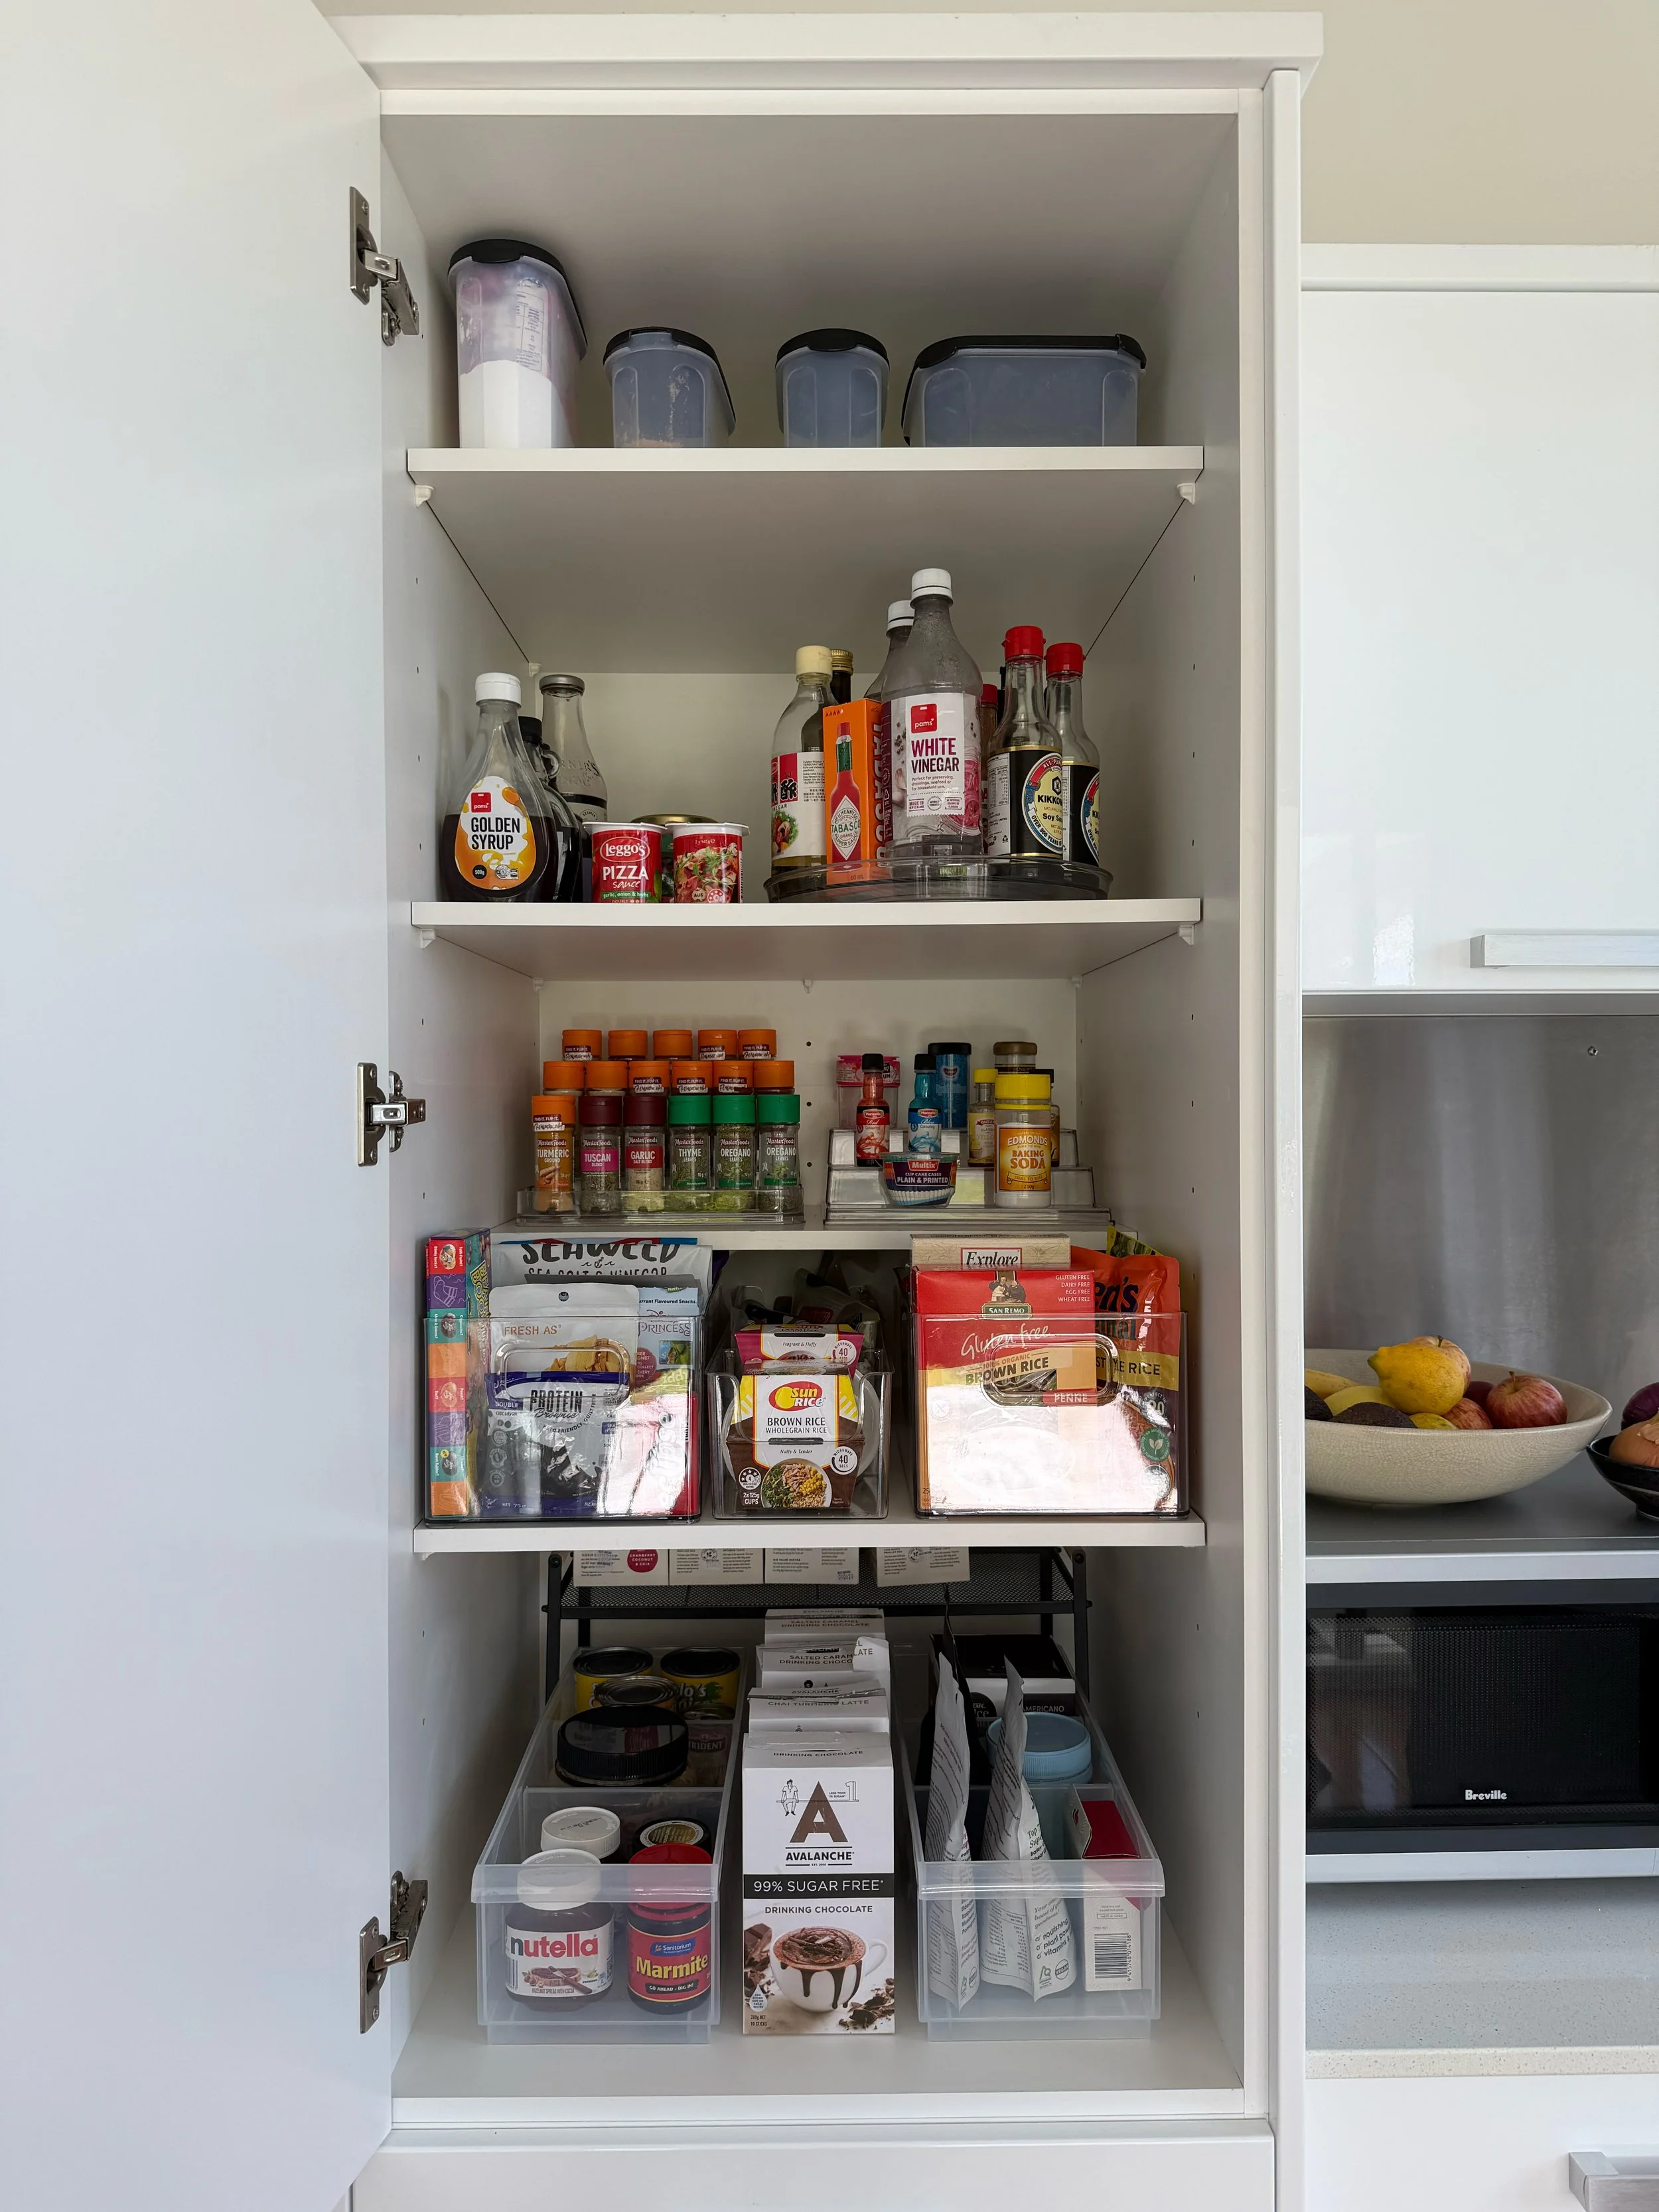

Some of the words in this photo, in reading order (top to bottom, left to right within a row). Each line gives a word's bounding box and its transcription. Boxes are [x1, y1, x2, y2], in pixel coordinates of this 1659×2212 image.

[914, 721, 933, 729] pams
[911, 737, 956, 758] WHITE
[911, 757, 959, 774] VINEGAR
[1043, 813, 1054, 822] Soy
[470, 816, 520, 833] GOLDEN
[831, 820, 860, 833] TABASCO
[1031, 815, 1041, 830] OVER
[1048, 834, 1058, 846] YEARS
[471, 834, 514, 850] SYRUP
[605, 842, 646, 857] Leggo's
[603, 865, 649, 881] PIZZA
[1007, 1136, 1048, 1146] EDMONDS
[538, 1149, 569, 1157] TURMERIC
[630, 1151, 655, 1160] GARLIC
[720, 1148, 751, 1157] OREGANO
[766, 1147, 796, 1155] OREGANO
[585, 1153, 611, 1162] TUSCAN
[1010, 1158, 1046, 1169] SODA
[521, 1244, 681, 1264] SEAWEED
[966, 1250, 1019, 1265] Explore
[504, 1326, 539, 1336] FRESH
[638, 1321, 690, 1337] PRINCESS
[961, 1332, 1015, 1360] Gluten
[1001, 1353, 1031, 1365] ORGANIC
[966, 1362, 1019, 1385] BROWN
[1022, 1357, 1048, 1371] RICE
[1129, 1361, 1161, 1375] RICE
[791, 1387, 818, 1398] Sun
[1054, 1394, 1088, 1403] PENNE
[530, 1390, 583, 1413] PROTEIN
[534, 1408, 578, 1418] Brownie
[767, 1417, 802, 1426] BROWN
[805, 1417, 826, 1426] RICE
[838, 1455, 848, 1464] 40
[688, 1741, 724, 1750] TRIDENT
[1465, 1789, 1507, 1801] Breville
[790, 1781, 848, 1843] A
[1027, 1828, 1037, 1839] Top
[786, 1851, 852, 1861] AVALANCHE
[753, 1881, 782, 1892] 99%
[787, 1880, 838, 1891] SUGAR
[1035, 1904, 1046, 1913] Your
[1043, 1917, 1068, 1941] nourishing
[510, 1933, 598, 1958] nutella
[1043, 1934, 1058, 1950] plant
[1044, 1939, 1066, 1957] vitamins
[636, 1954, 708, 1978] Marmite
[1055, 1964, 1069, 1976] VEGAN
